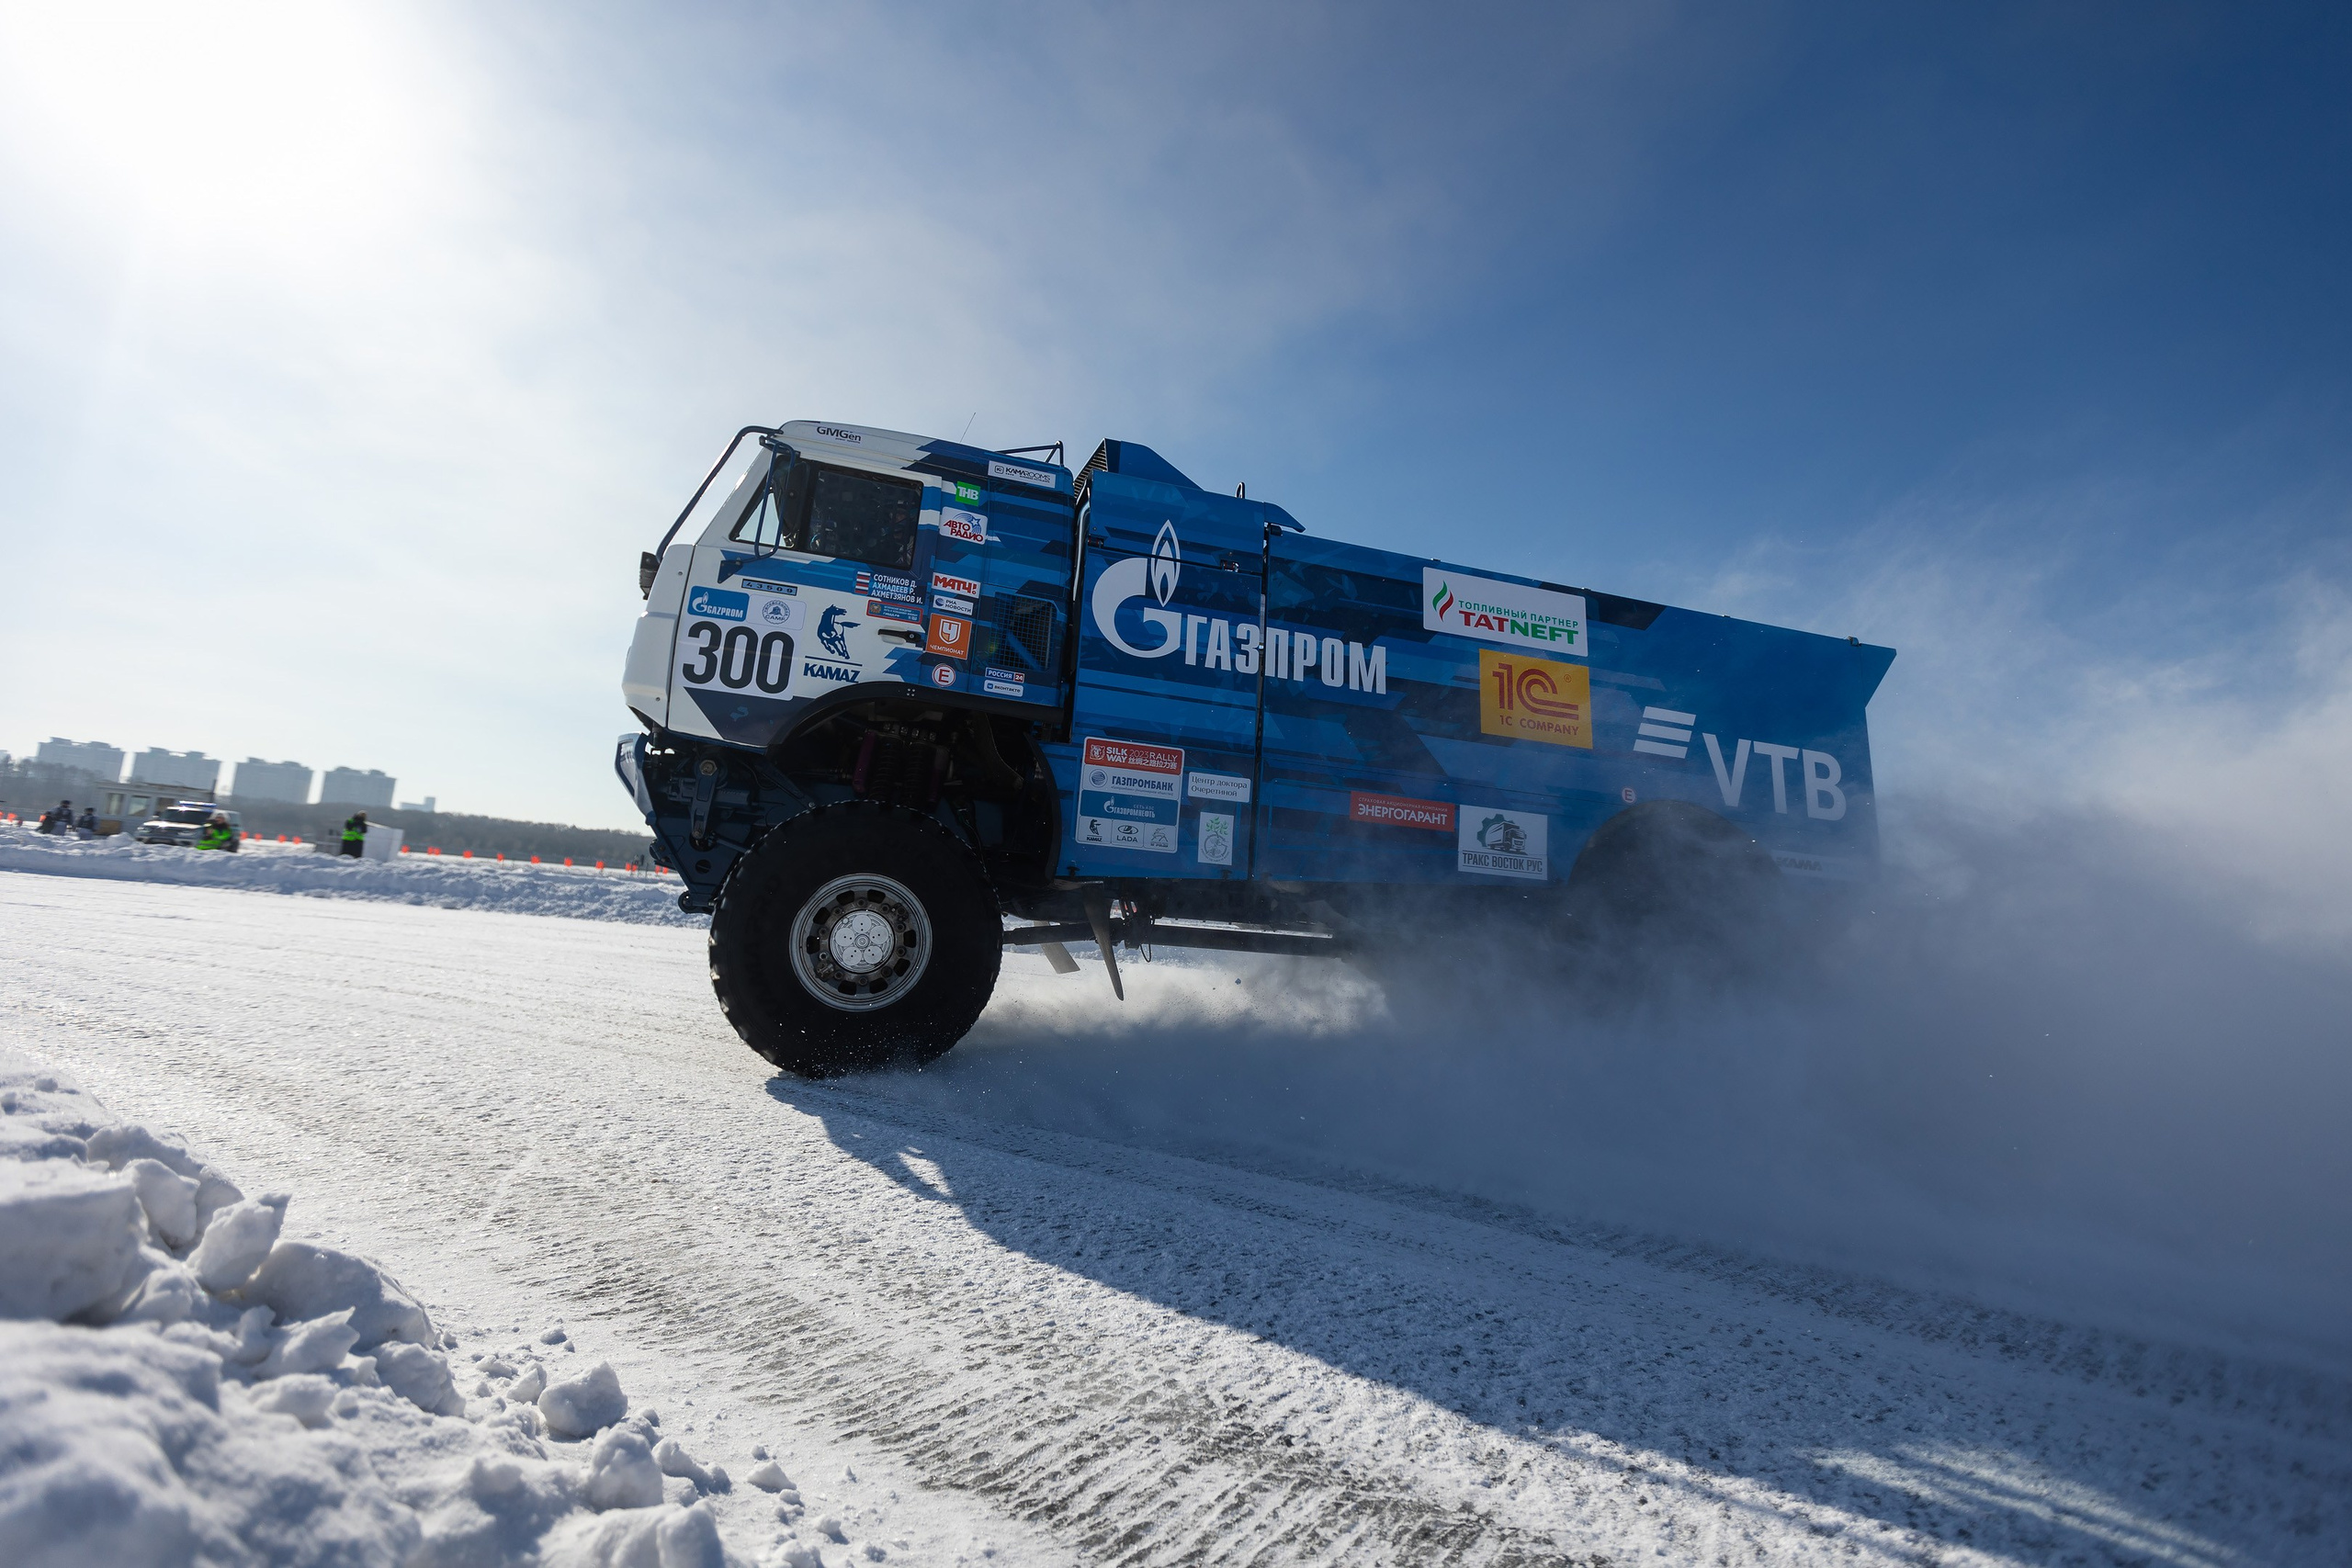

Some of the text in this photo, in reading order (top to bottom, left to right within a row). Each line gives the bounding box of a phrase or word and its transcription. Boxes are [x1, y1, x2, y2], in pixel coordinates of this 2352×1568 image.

[817, 426, 862, 442] GMGen
[1005, 467, 1051, 481] KAMAROOMS
[944, 520, 971, 532] АВТО
[950, 527, 984, 542] РАДИО
[872, 582, 908, 593] АХМАДЕЕВ
[874, 574, 910, 586] СОТНИКОВ
[933, 575, 977, 595] МАТЧ!
[871, 590, 915, 604] АХМЕТЗЯНОВ
[707, 604, 743, 618] GAZPROM
[944, 604, 972, 614] НОВОСТИ
[1458, 600, 1578, 628] ТОПЛИВНЫЙ ПАРТНЕР
[1459, 610, 1578, 645] TATNEFT
[683, 621, 795, 694] 300
[930, 644, 965, 656] ЧЕМПИОНАТ
[1185, 615, 1386, 694] ГАЗПРОМ
[803, 662, 860, 683] KAMAZ
[988, 670, 1012, 680] РОССИЯ
[1520, 718, 1579, 736] COMPANY
[1106, 746, 1178, 762] SILK 2023 RALLY
[1106, 753, 1127, 763] WAY
[1112, 775, 1174, 791] ГАЗПРОМБАНК
[1192, 775, 1248, 789] Центр доктора
[1702, 733, 1847, 821] VTB
[1191, 785, 1238, 796] Очеретиной
[1358, 803, 1448, 826] ЭНЕРГОГАРАНТ
[1463, 852, 1543, 873] ТРАКС ВОСТОК РУС
